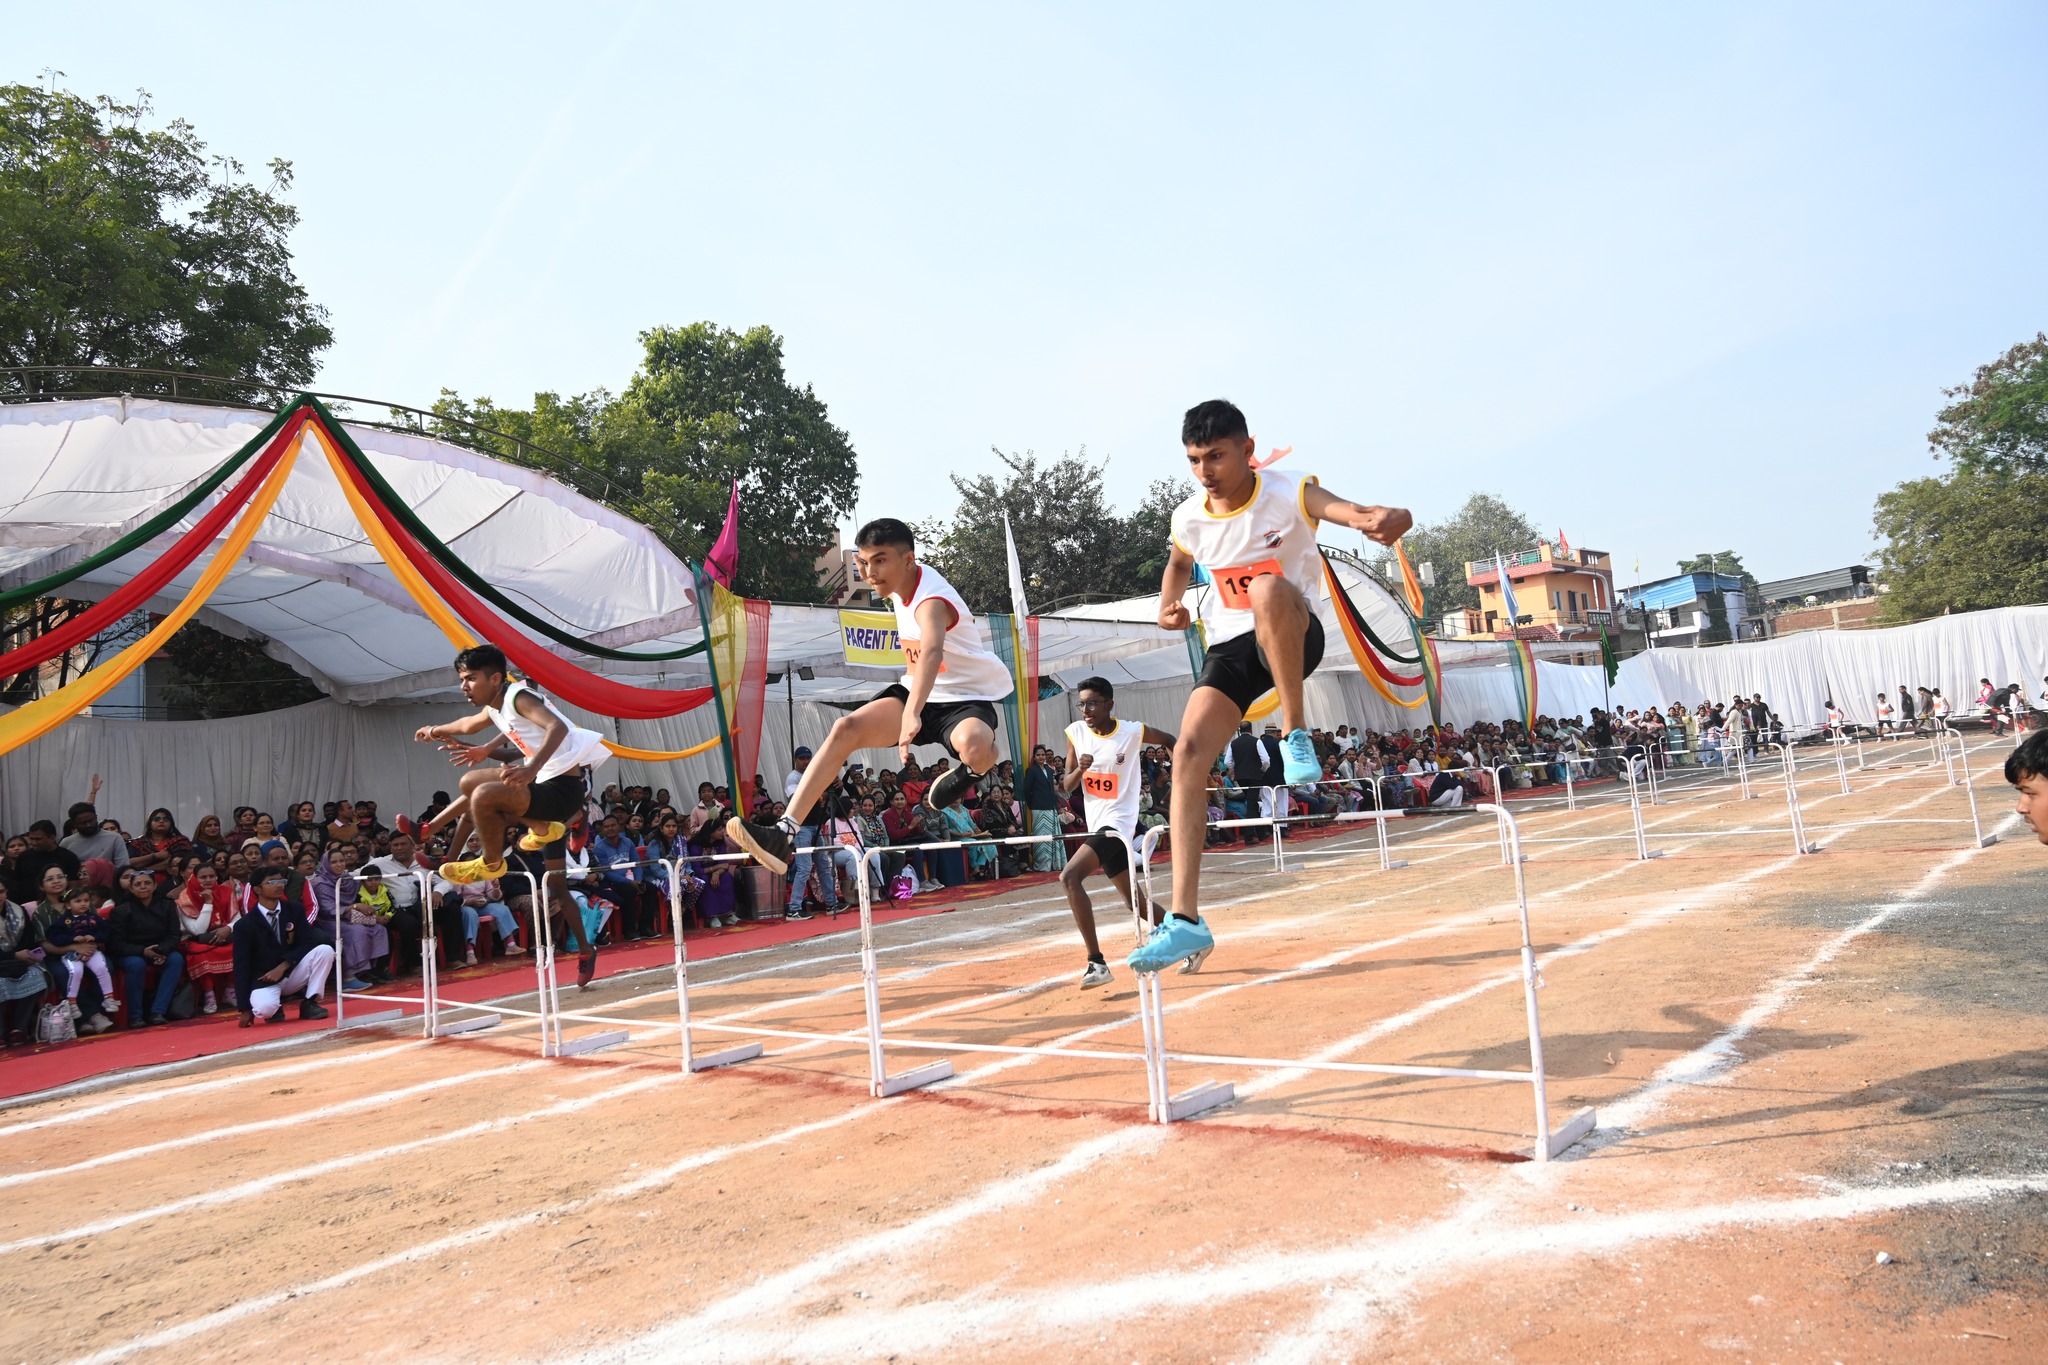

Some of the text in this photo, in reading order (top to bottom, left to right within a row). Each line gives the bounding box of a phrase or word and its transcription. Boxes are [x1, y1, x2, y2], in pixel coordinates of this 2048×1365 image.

[1225, 572, 1272, 595] 19
[845, 626, 888, 650] PARENT
[1087, 777, 1113, 792] 219
